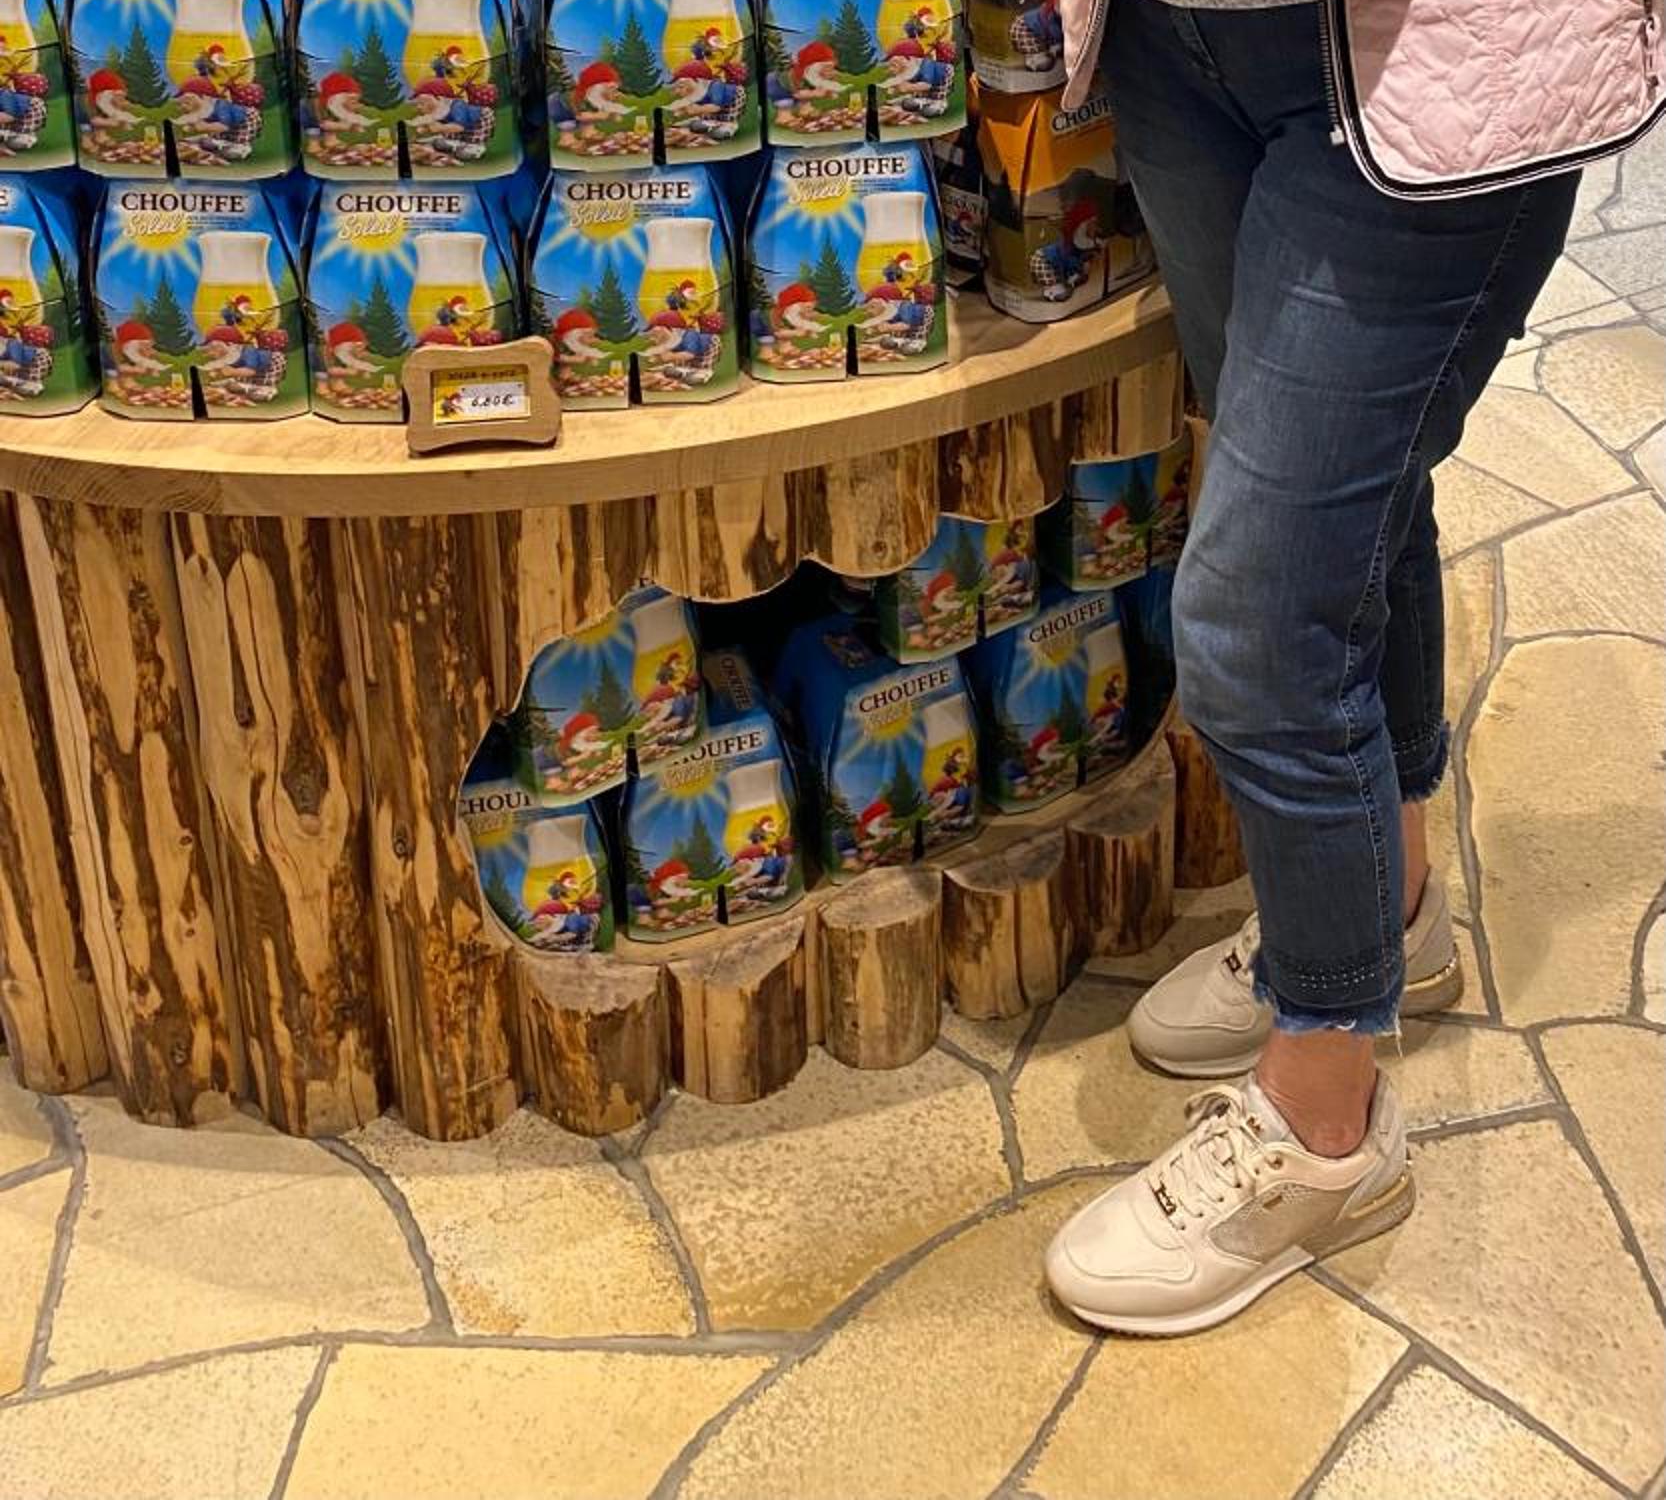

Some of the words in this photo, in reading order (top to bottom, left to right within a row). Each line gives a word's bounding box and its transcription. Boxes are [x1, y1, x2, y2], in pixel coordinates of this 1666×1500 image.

[787, 156, 905, 178] CHOUFFE
[121, 192, 245, 213] CHOUFFE
[336, 194, 462, 213] CHOUFFE
[567, 181, 692, 201] CHOUFFE
[124, 211, 186, 238] Soleil
[570, 199, 630, 227] Soleil
[338, 213, 401, 241] Soleil
[1029, 597, 1106, 644] CHOUFFE
[859, 667, 951, 714] CHOUFFE
